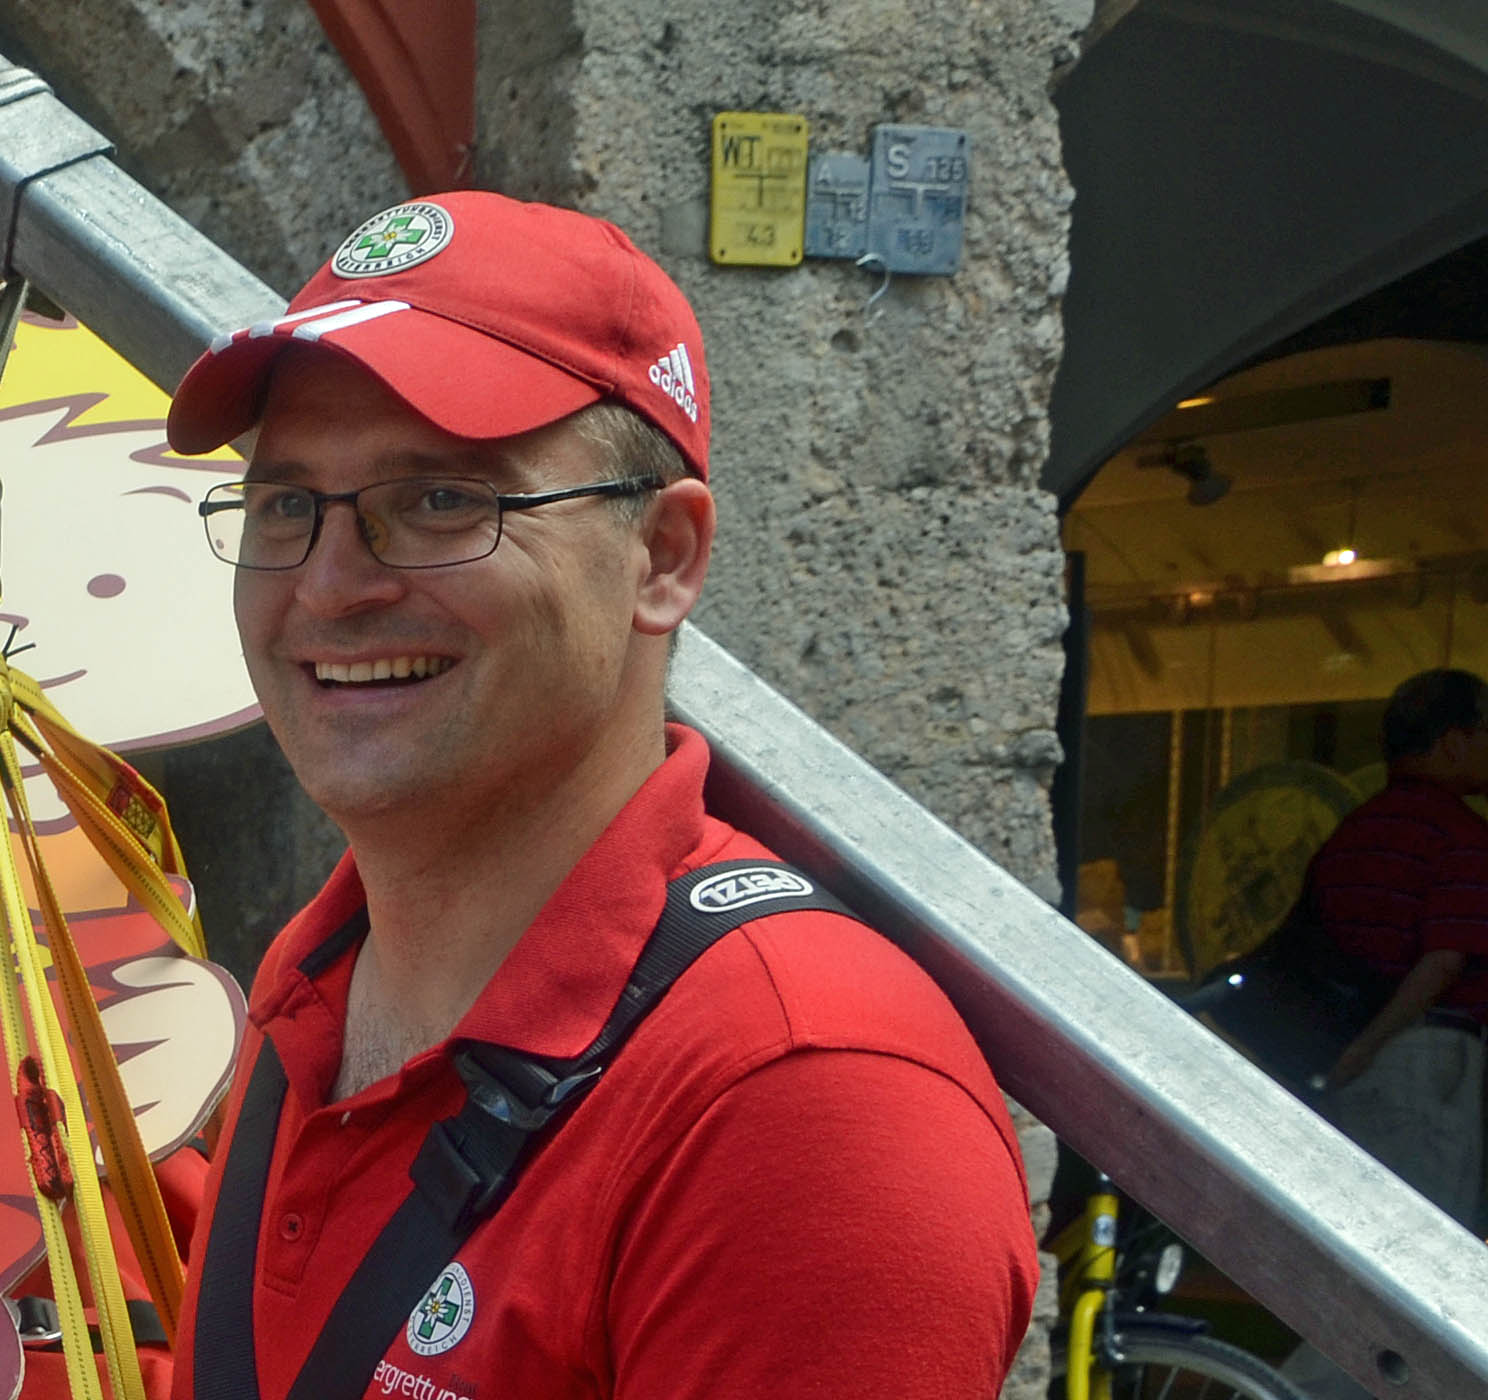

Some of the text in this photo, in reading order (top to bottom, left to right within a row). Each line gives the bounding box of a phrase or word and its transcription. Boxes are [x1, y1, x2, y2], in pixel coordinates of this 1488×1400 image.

[721, 135, 762, 170] WT
[886, 143, 912, 179] S
[648, 364, 698, 424] adidas
[700, 870, 805, 905] PETZL
